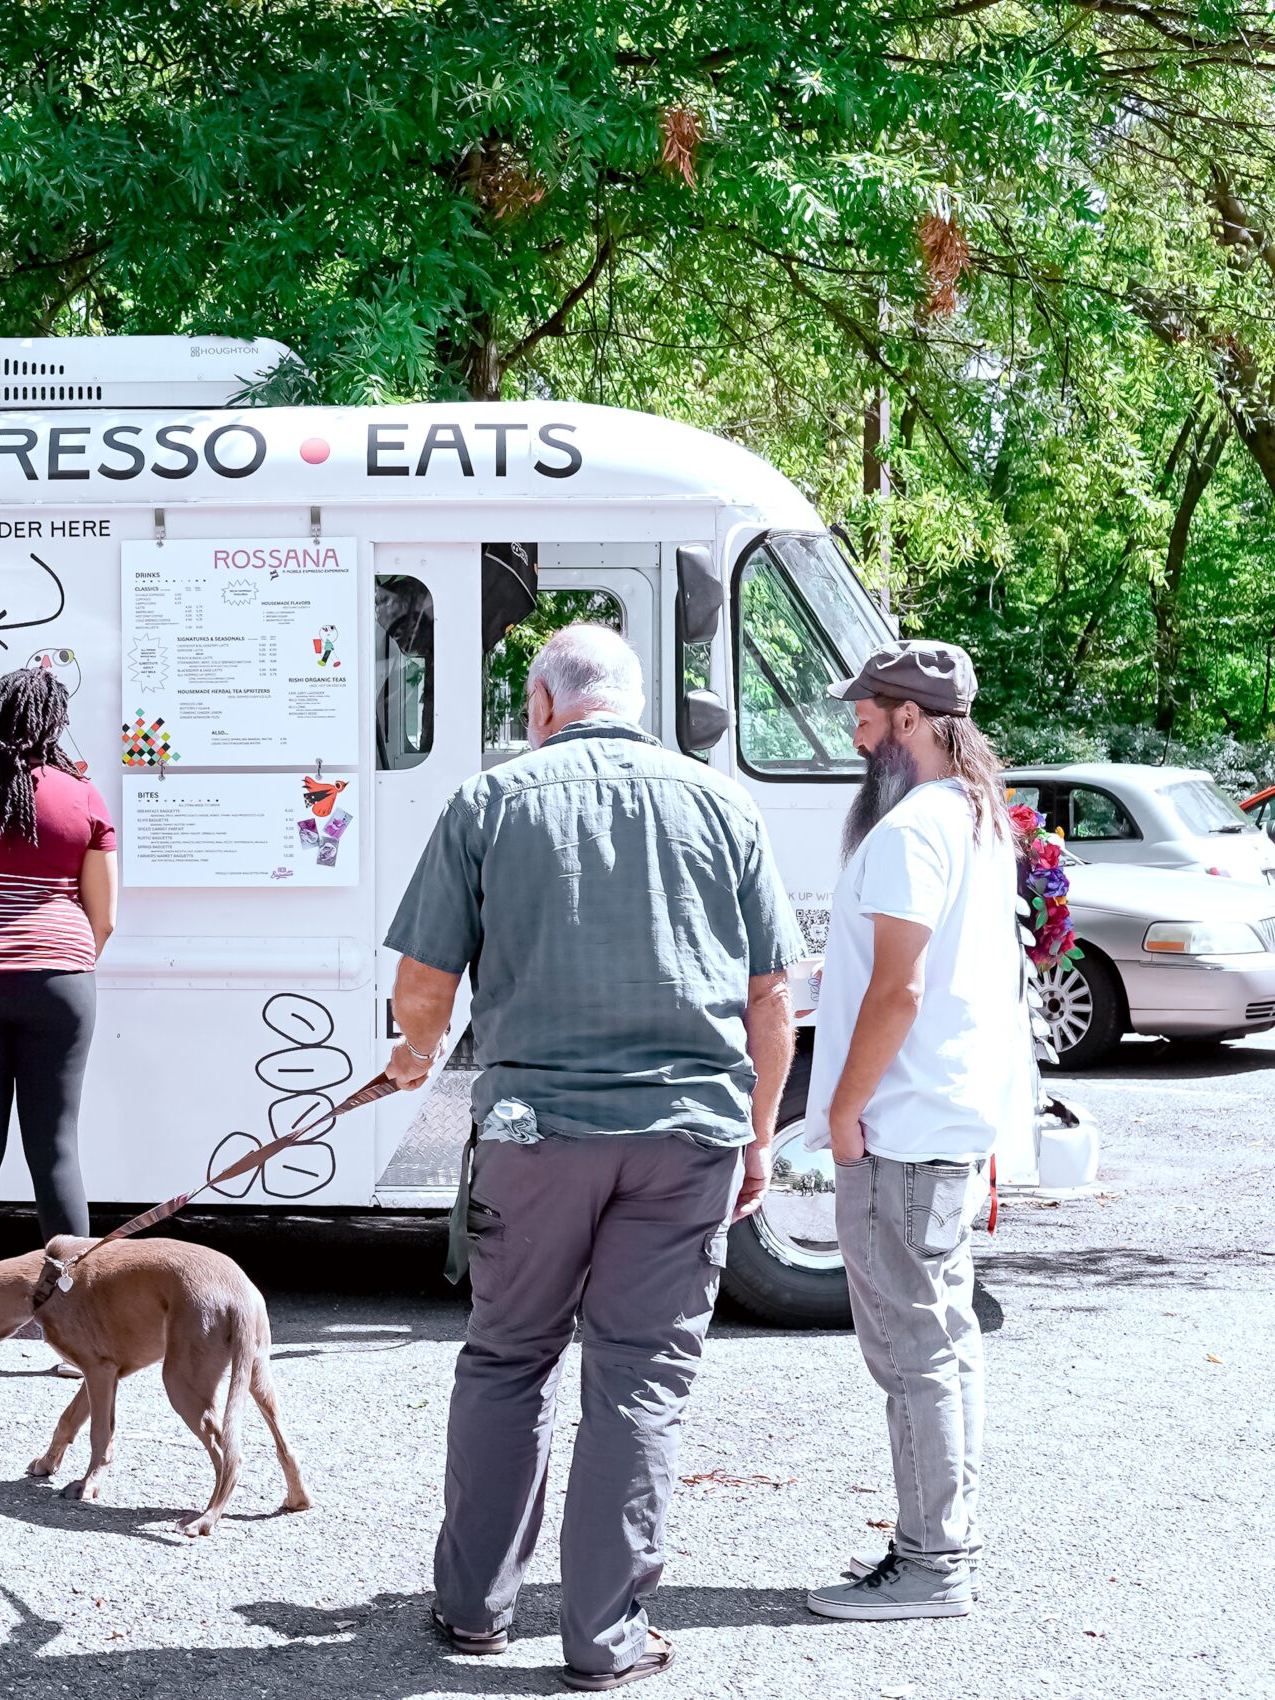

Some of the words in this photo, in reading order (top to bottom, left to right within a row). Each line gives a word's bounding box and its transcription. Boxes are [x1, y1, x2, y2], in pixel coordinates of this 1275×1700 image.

[200, 346, 259, 356] HOUGHTON
[367, 424, 582, 478] EATS
[51, 520, 110, 537] HERE
[214, 548, 340, 569] ROSSANA
[798, 892, 813, 900] UP
